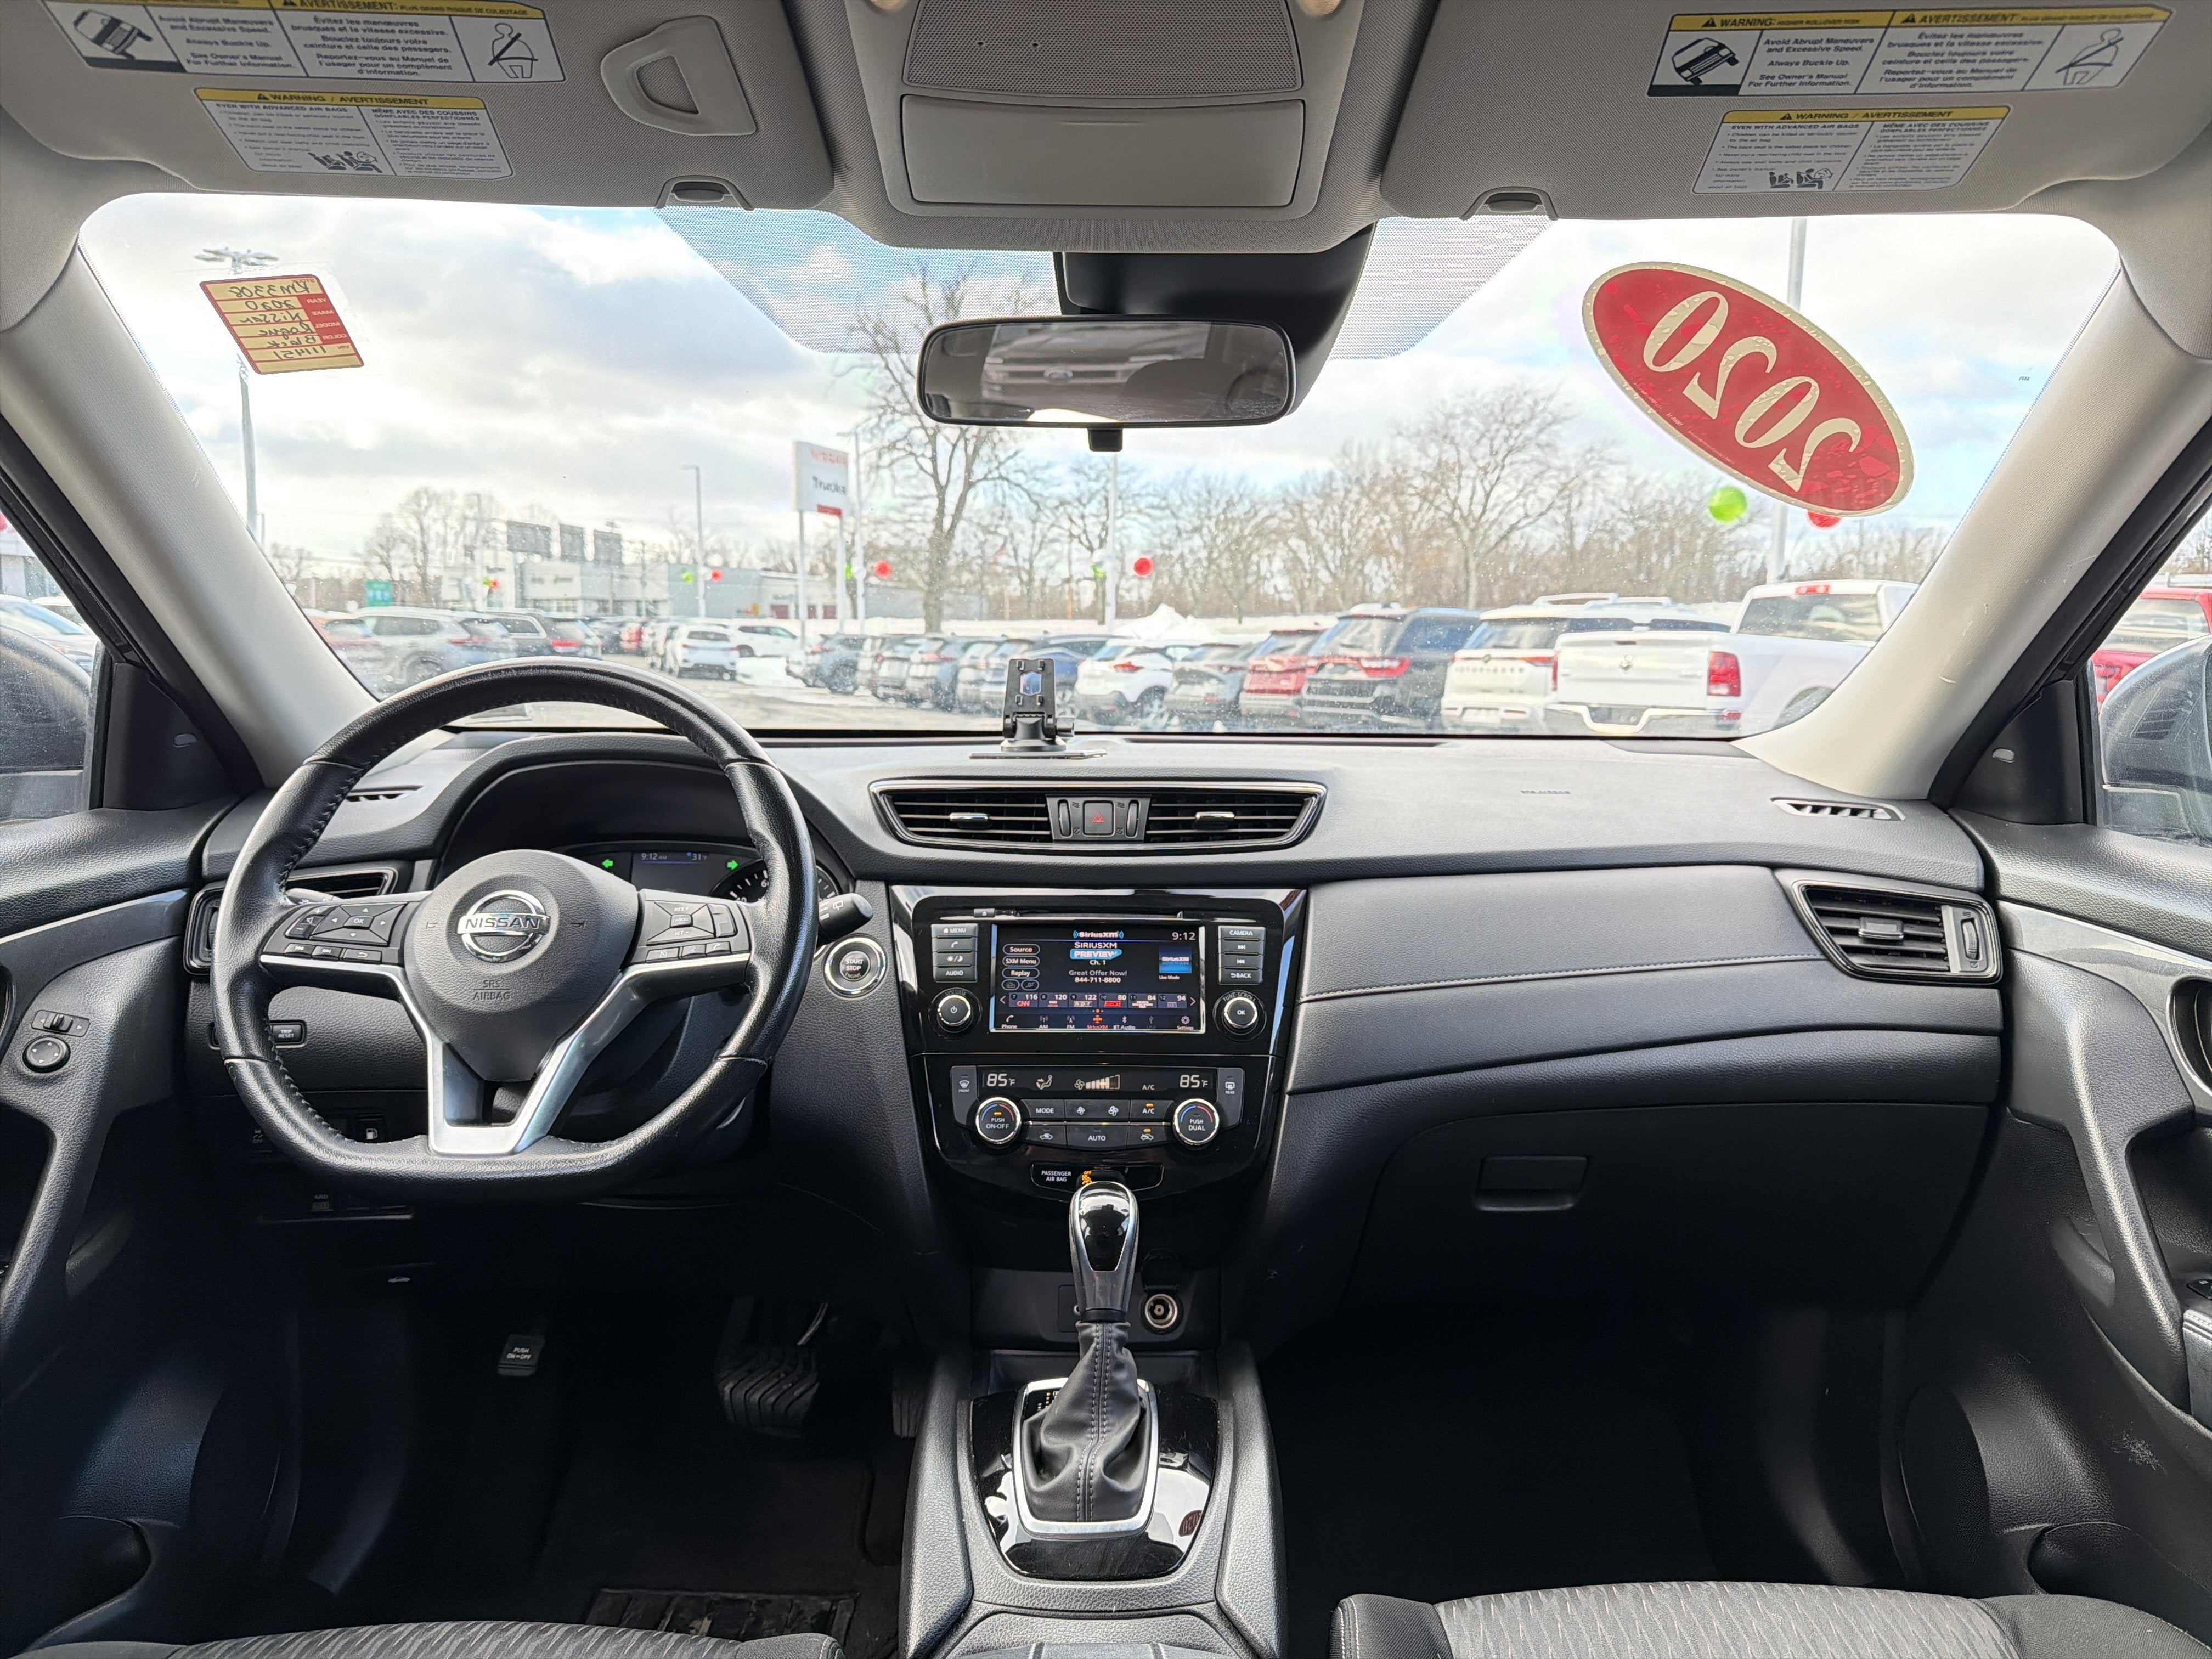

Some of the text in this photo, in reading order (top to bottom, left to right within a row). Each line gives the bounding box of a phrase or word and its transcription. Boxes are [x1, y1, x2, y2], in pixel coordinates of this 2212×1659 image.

[272, 94, 429, 105] WARNING AVERTISSEMENT
[465, 917, 540, 929] NISSAN
[1172, 932, 1196, 941] 9:12
[483, 980, 501, 988] SRS
[473, 991, 511, 1000] AIRBAG
